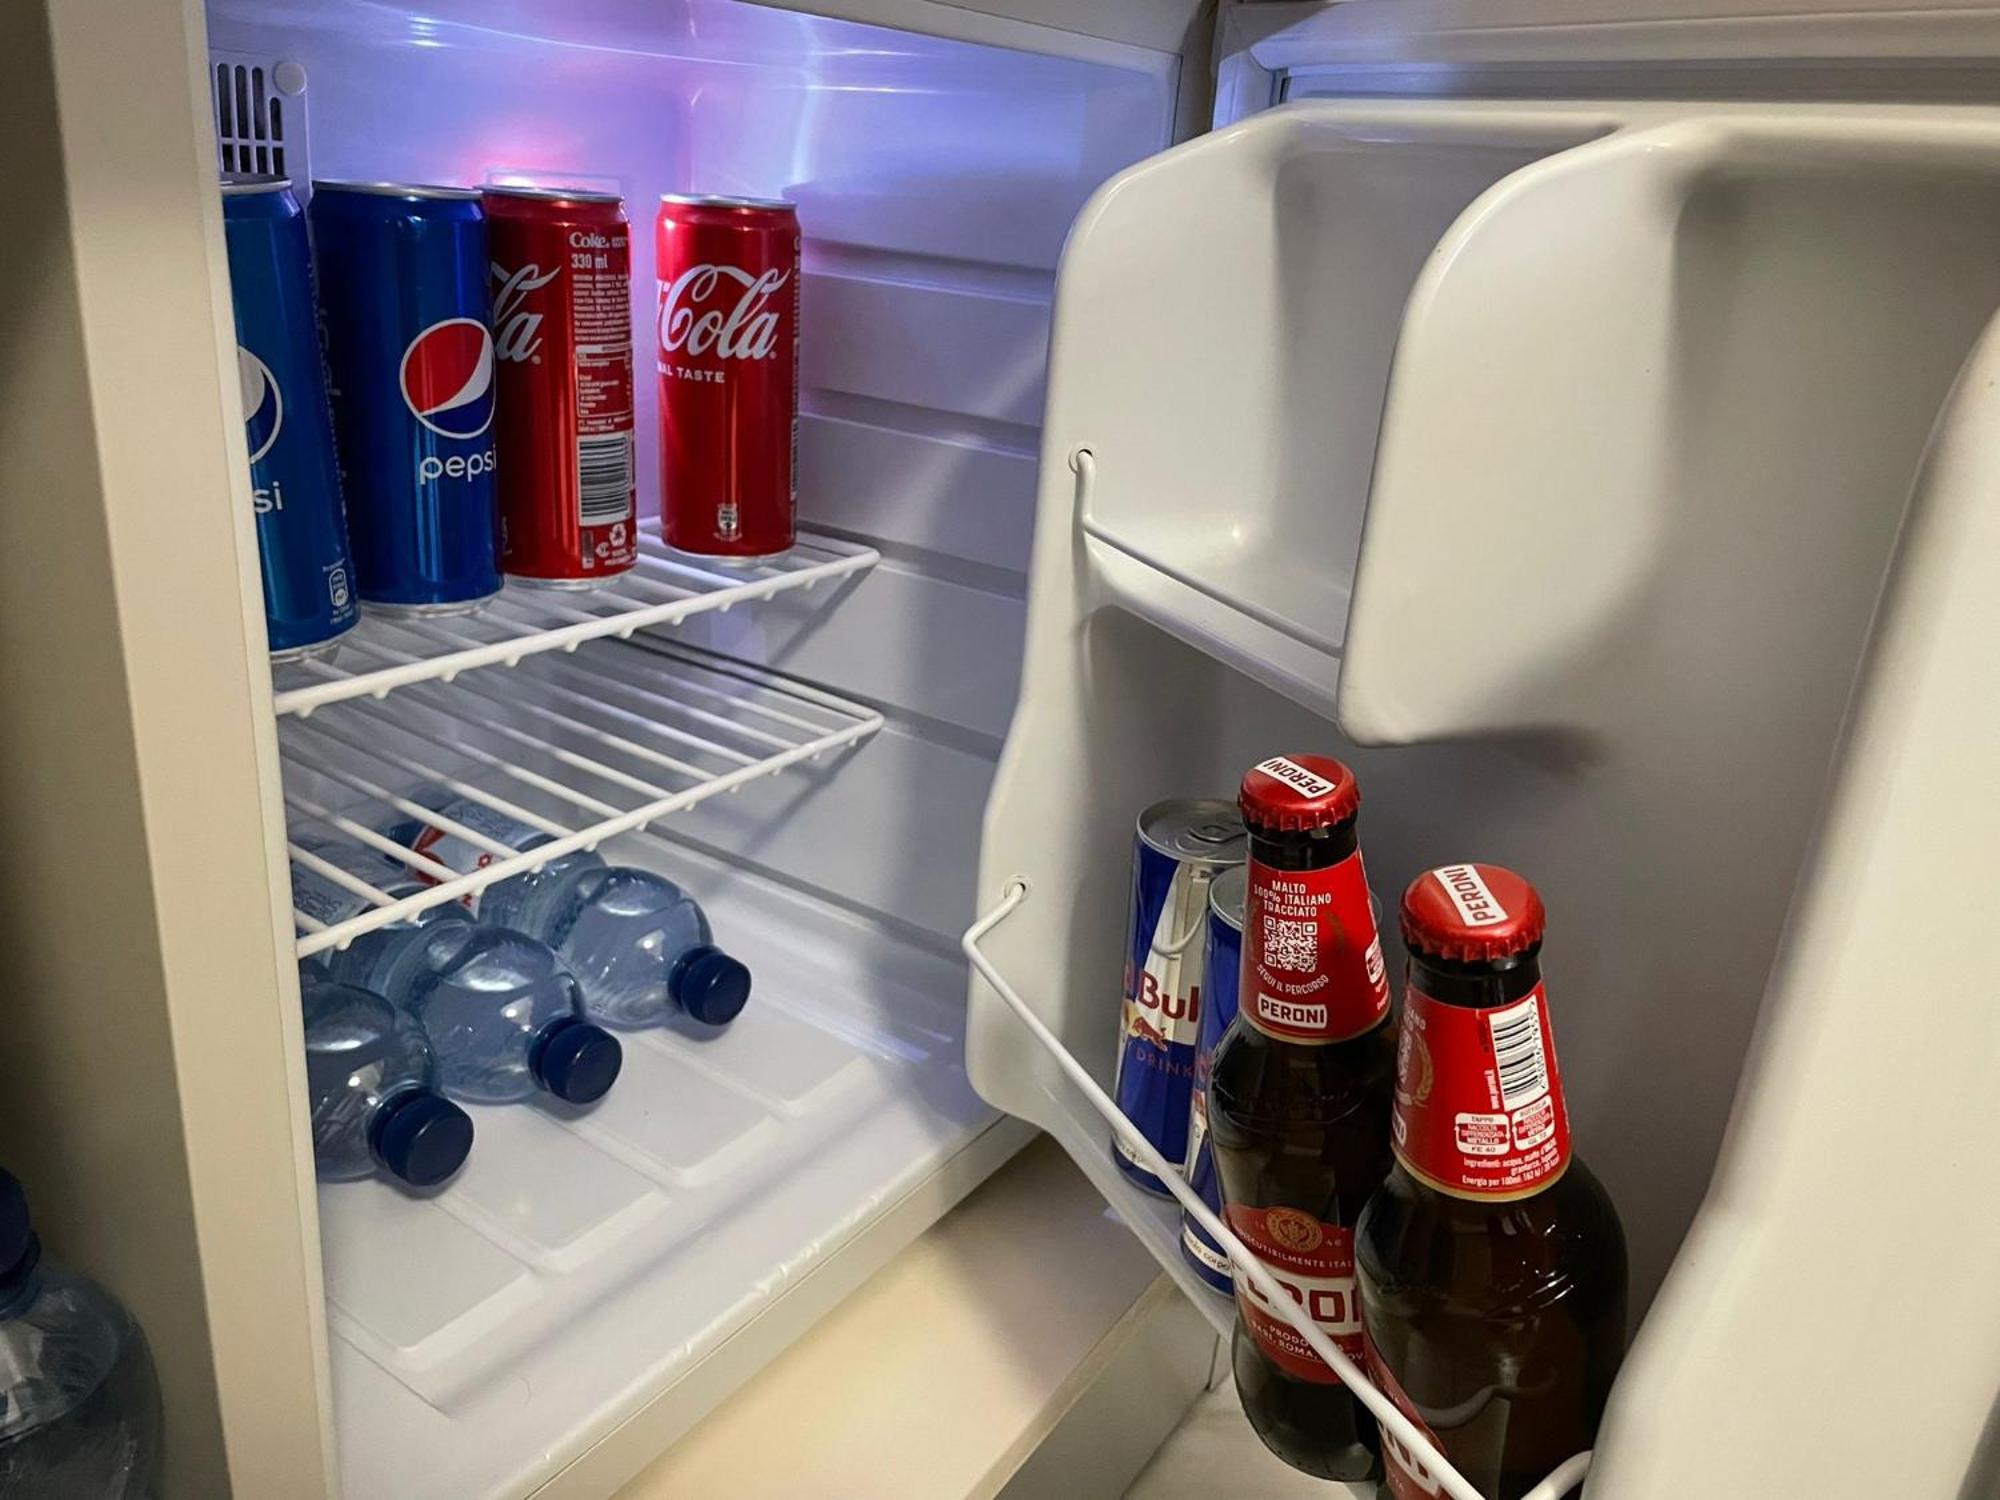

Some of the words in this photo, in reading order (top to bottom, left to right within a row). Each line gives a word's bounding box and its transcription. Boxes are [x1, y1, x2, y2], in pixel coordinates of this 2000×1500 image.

[571, 253, 592, 269] 330
[595, 254, 608, 269] ml
[661, 264, 791, 360] Cola
[676, 366, 726, 384] TASTE
[419, 443, 497, 486] pepsi
[1263, 758, 1328, 795] PERONI
[1253, 883, 1282, 903] 100%
[1284, 892, 1332, 906] ITALIANO
[1271, 880, 1307, 895] MALTO
[1444, 867, 1497, 923] PERONI
[1263, 900, 1317, 917] TRACCIATO
[1275, 981, 1283, 993] IL
[1284, 974, 1329, 996] PERCORSO
[1260, 998, 1326, 1023] PERONI
